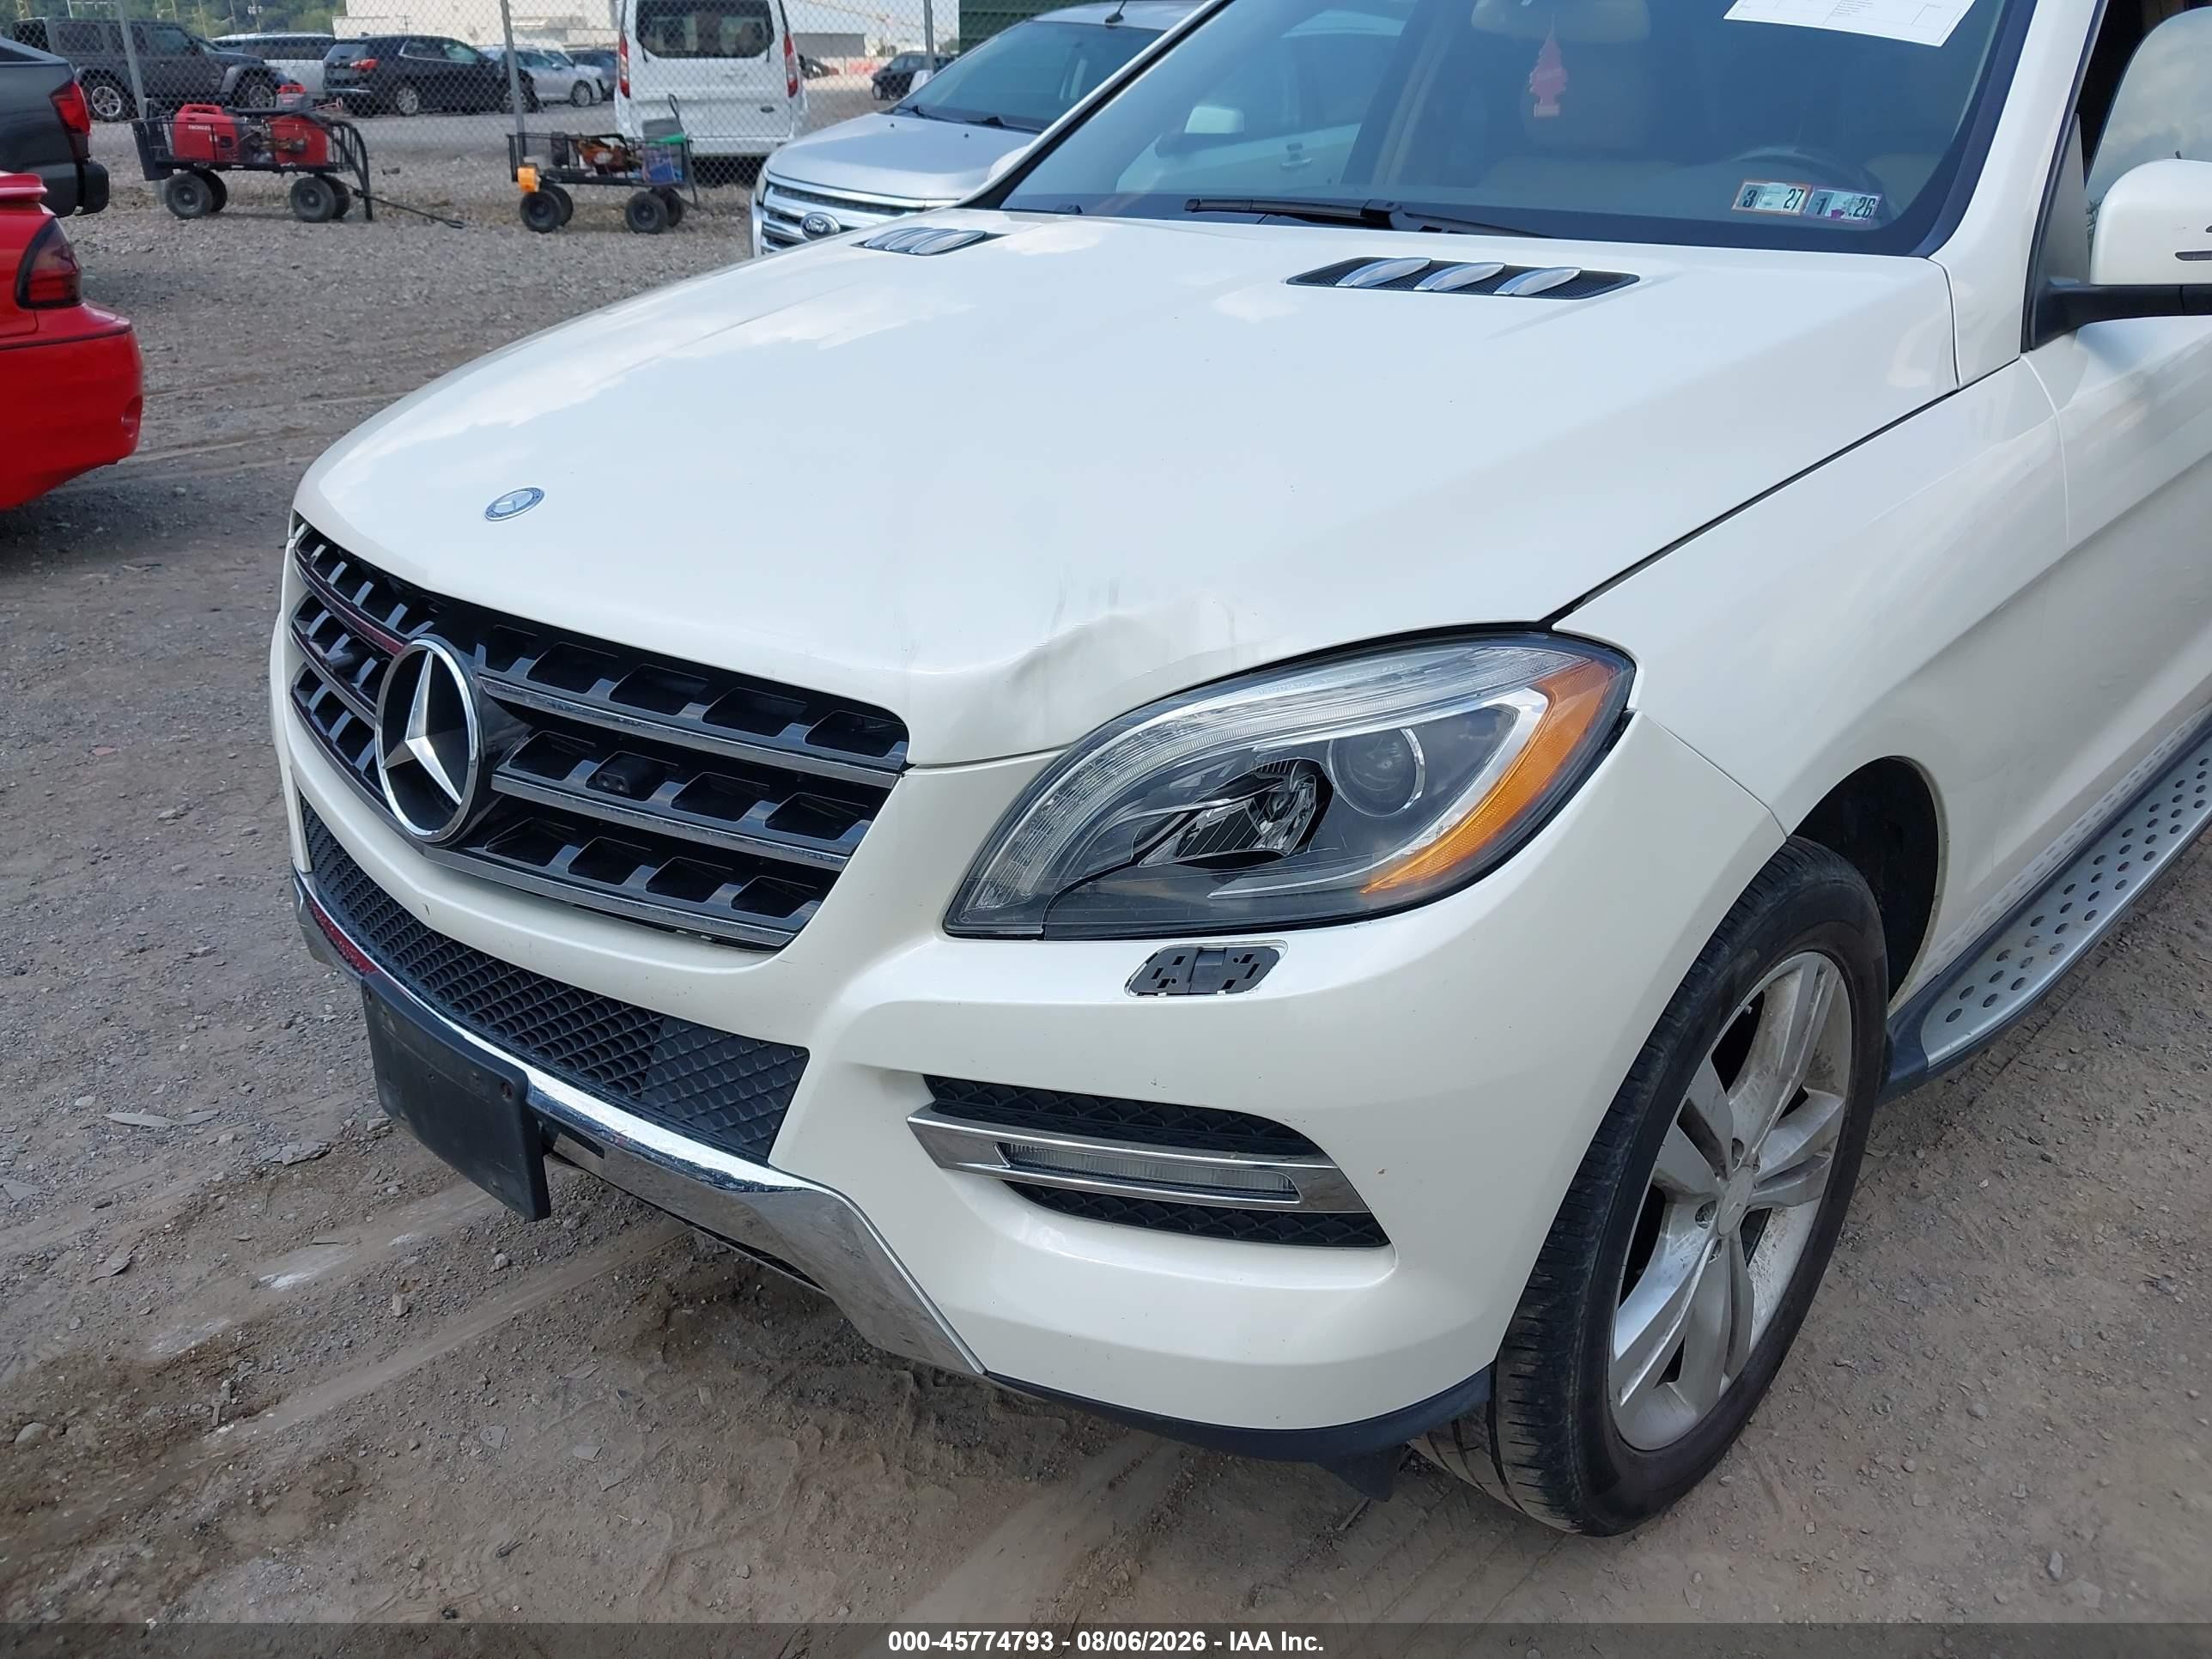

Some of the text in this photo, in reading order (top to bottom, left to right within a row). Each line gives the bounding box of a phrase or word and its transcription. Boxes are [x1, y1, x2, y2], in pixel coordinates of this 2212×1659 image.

[1742, 190, 1758, 208] 3
[1783, 188, 1805, 211] 27
[1853, 197, 1876, 218] 26
